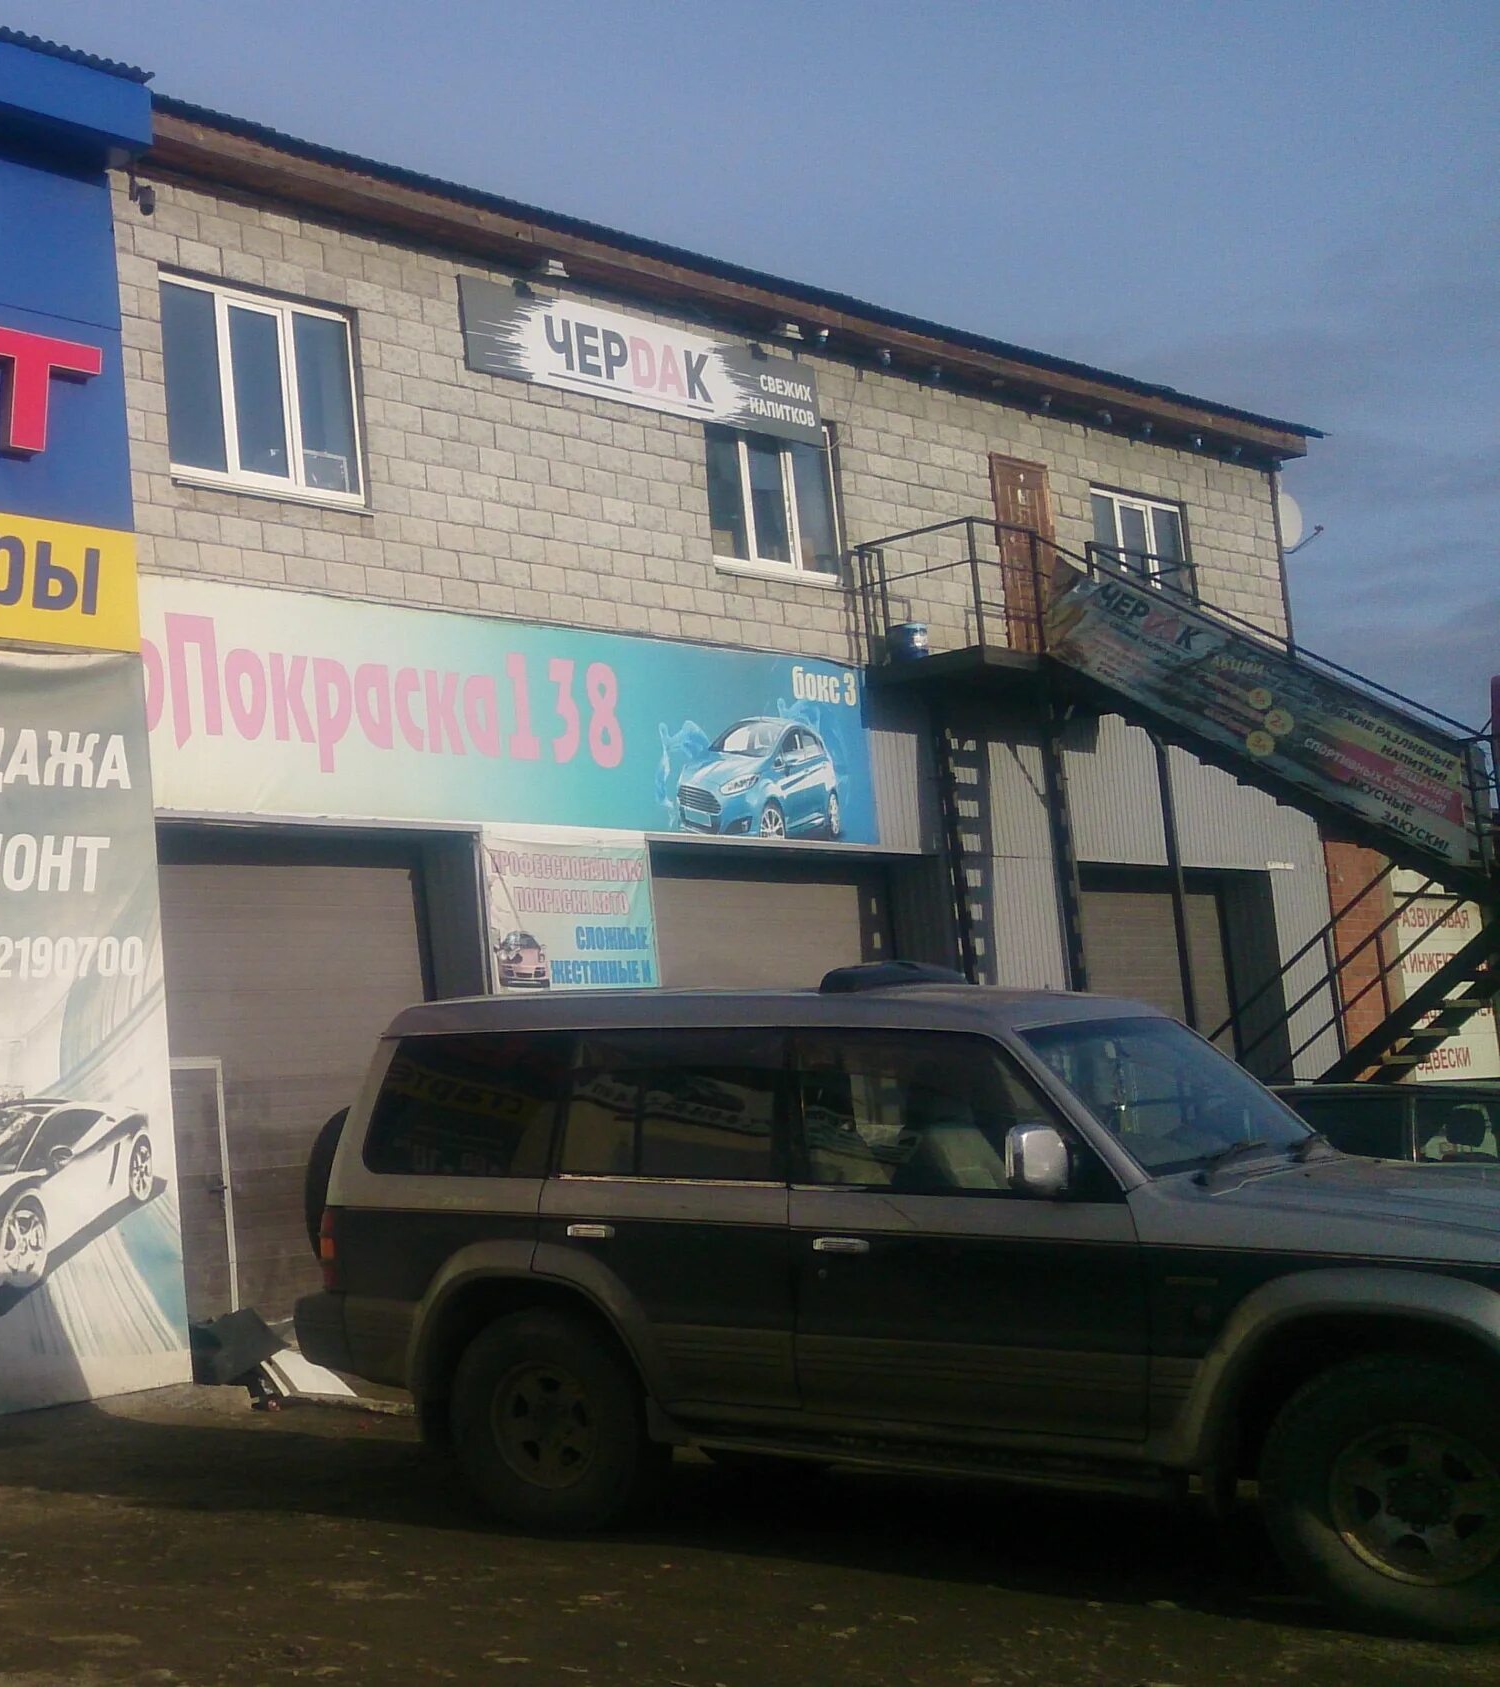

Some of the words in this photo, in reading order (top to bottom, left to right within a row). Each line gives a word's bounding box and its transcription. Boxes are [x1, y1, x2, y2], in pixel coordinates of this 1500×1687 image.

[759, 374, 813, 402] СВЕЖИХ
[750, 397, 816, 428] НАПИТКОВ
[1098, 581, 1206, 651] ЧЕРК
[792, 665, 841, 704] бокс
[843, 672, 857, 706] 3
[1375, 723, 1456, 771] РАЗЛИВНЫЕ
[1380, 745, 1448, 782] НАПИТКИ!
[1380, 810, 1451, 851] ЗАКУСКИ!
[513, 886, 592, 914] ПОКРАСКА
[592, 890, 630, 915] АВТО
[574, 925, 650, 951] СЛОЖНЫЕ
